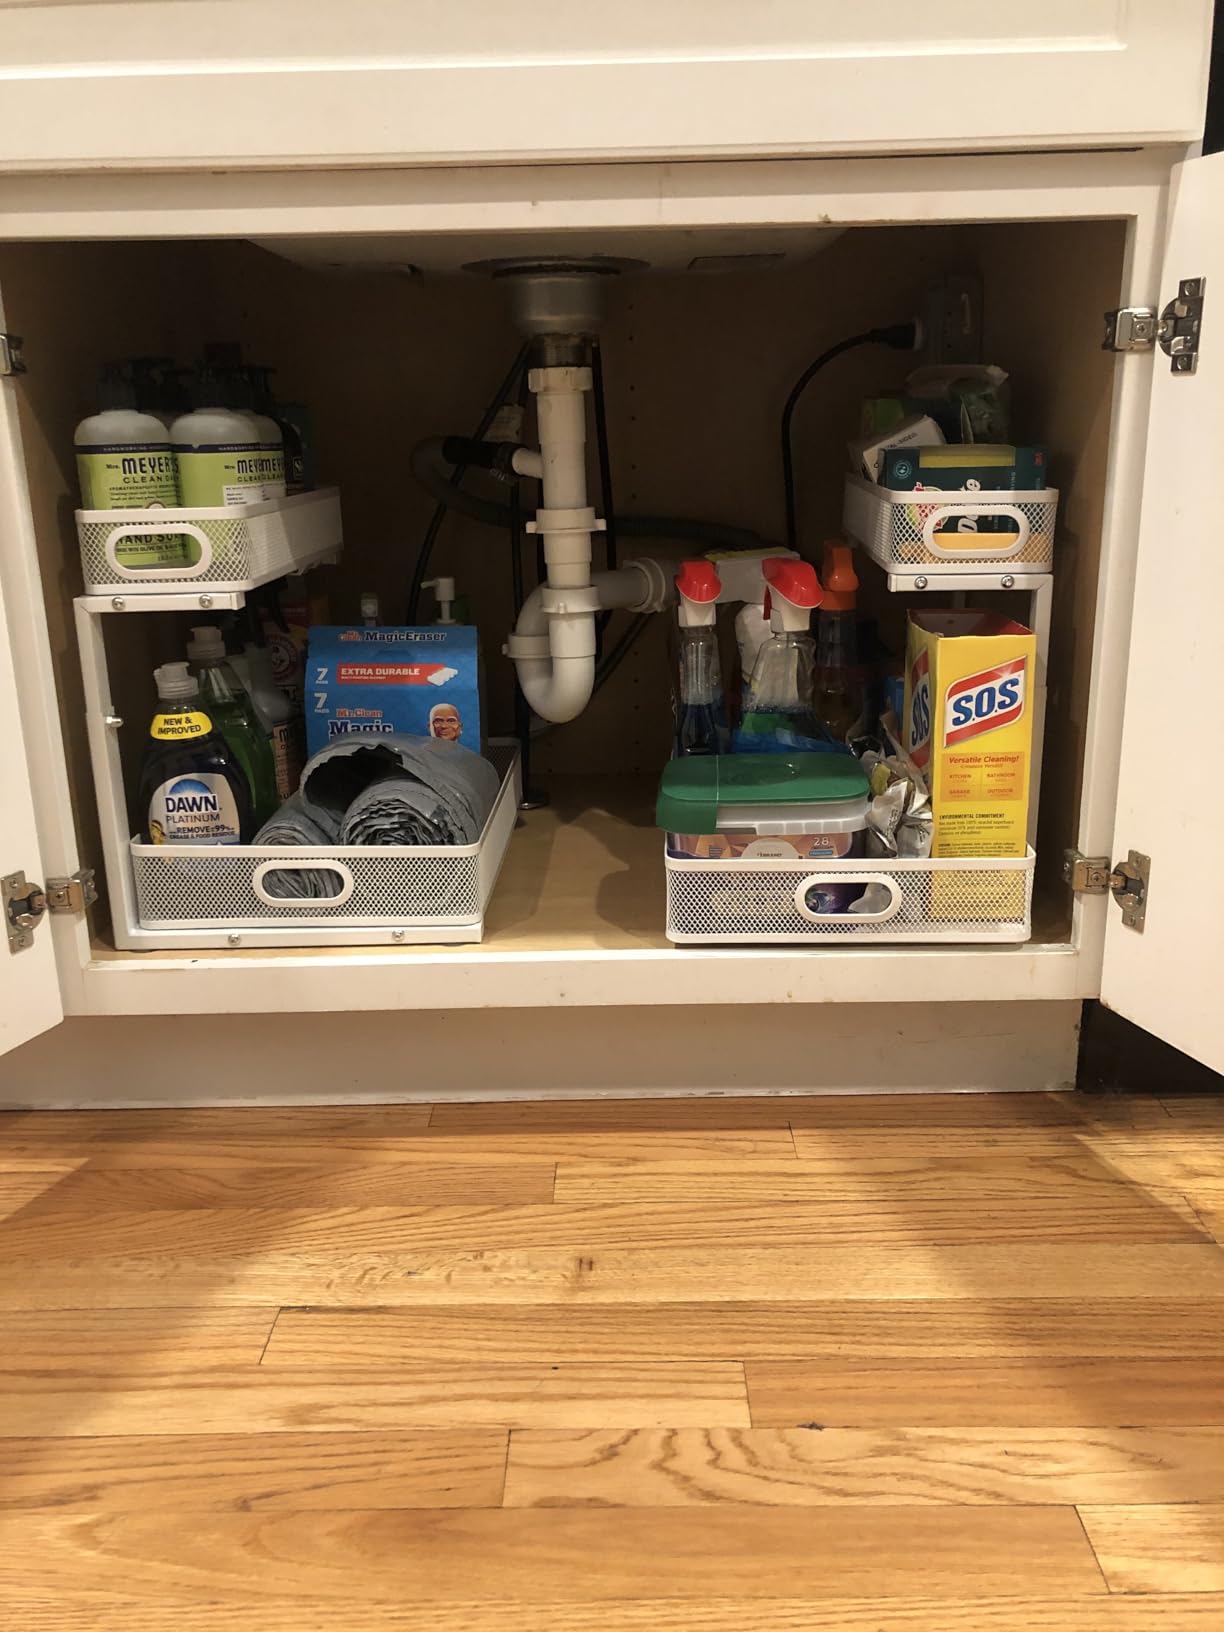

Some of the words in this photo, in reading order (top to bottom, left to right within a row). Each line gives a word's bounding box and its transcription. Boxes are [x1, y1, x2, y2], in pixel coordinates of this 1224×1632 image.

[123, 476, 164, 484] CLEAN
[341, 668, 374, 676] EXTRA
[375, 668, 421, 676] DURABLE
[314, 692, 328, 709] 7
[163, 717, 183, 727] NEW
[184, 716, 192, 725] &
[157, 725, 201, 736] IMPROVED
[949, 756, 982, 764] Versatile
[164, 795, 218, 813] DAWN
[165, 813, 220, 824] PLATINUM
[813, 837, 829, 846] 28
